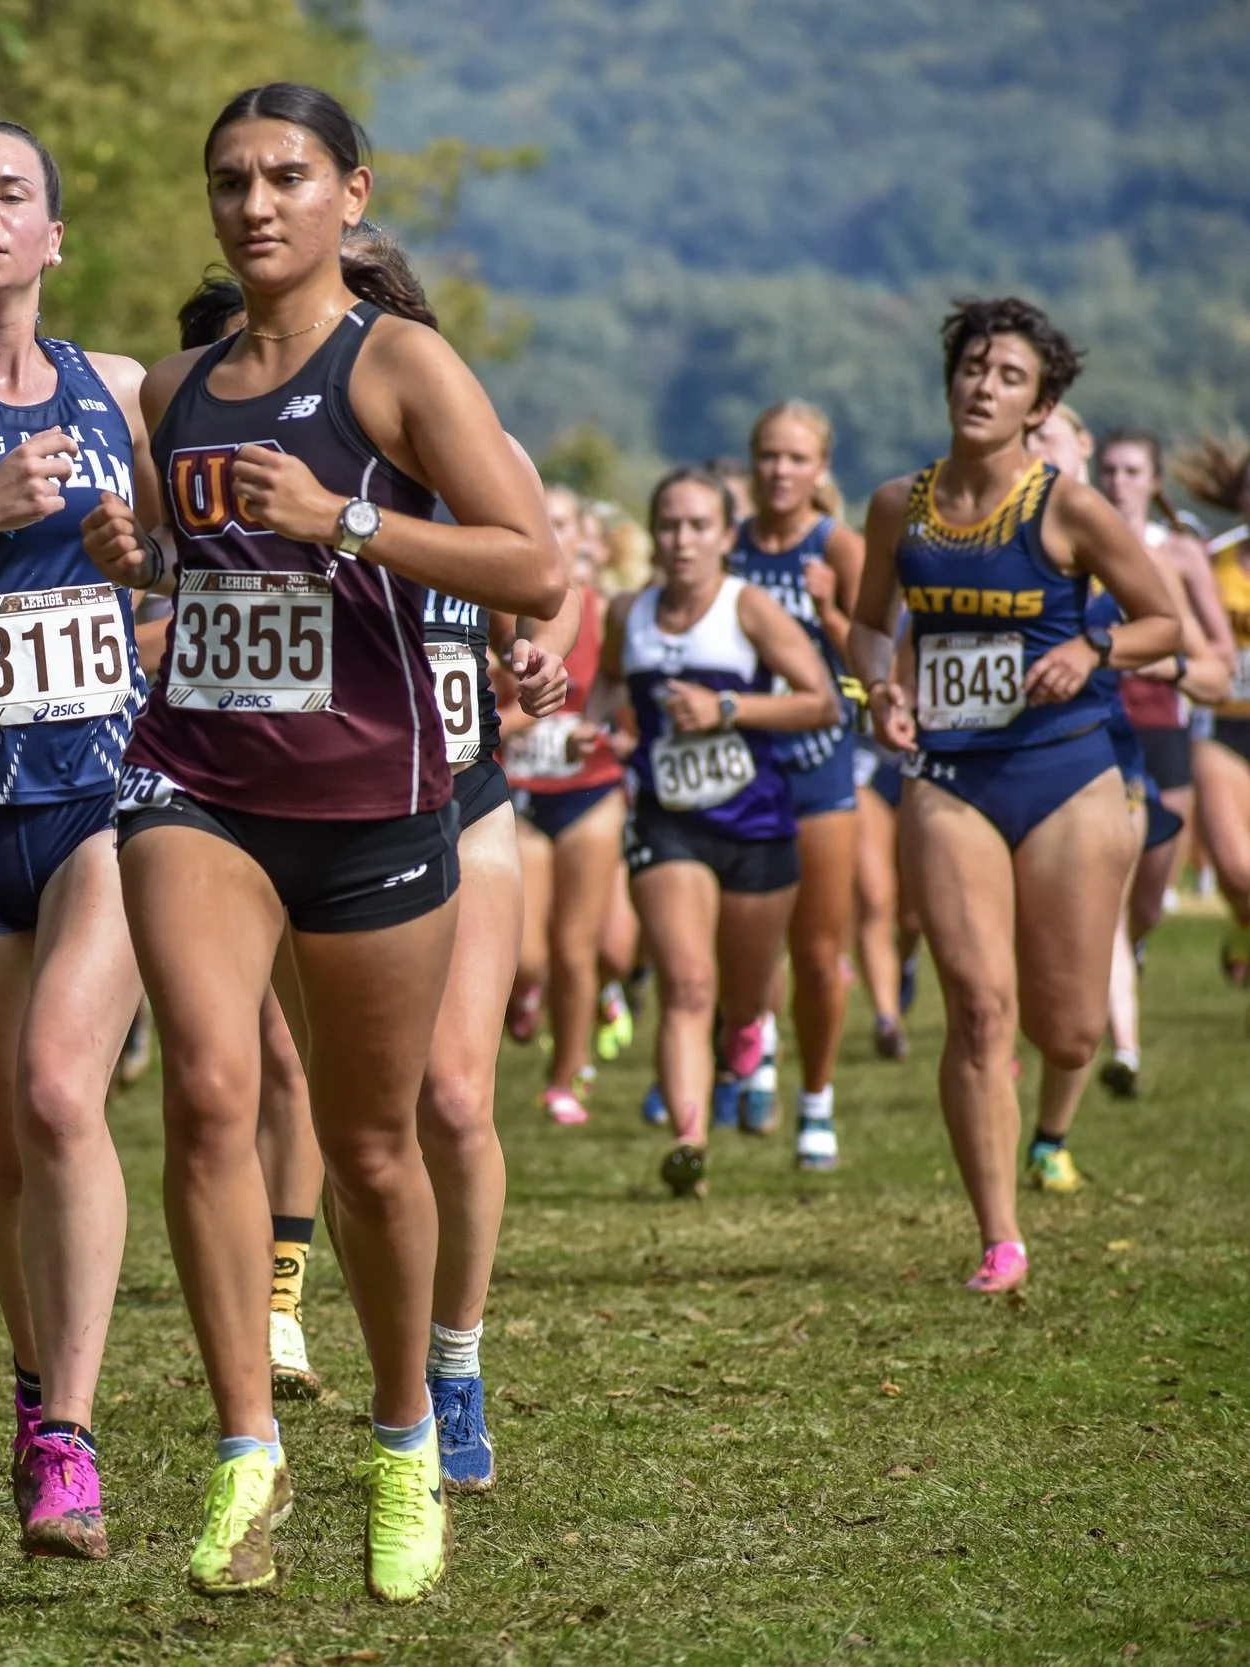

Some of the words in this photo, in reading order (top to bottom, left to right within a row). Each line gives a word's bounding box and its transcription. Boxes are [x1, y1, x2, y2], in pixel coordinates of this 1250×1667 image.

[219, 576, 262, 590] LEHIGH
[286, 585, 309, 593] Short
[80, 588, 97, 597] 2023
[19, 592, 65, 610] LEHIGH
[81, 597, 99, 605] Short
[99, 595, 114, 603] Run
[902, 586, 1045, 618] ATORS
[177, 602, 323, 681] 3355
[439, 645, 456, 653] 2023
[925, 655, 1017, 707] 1843
[234, 694, 272, 708] asics
[51, 702, 85, 717] asics
[658, 741, 746, 795] 3048
